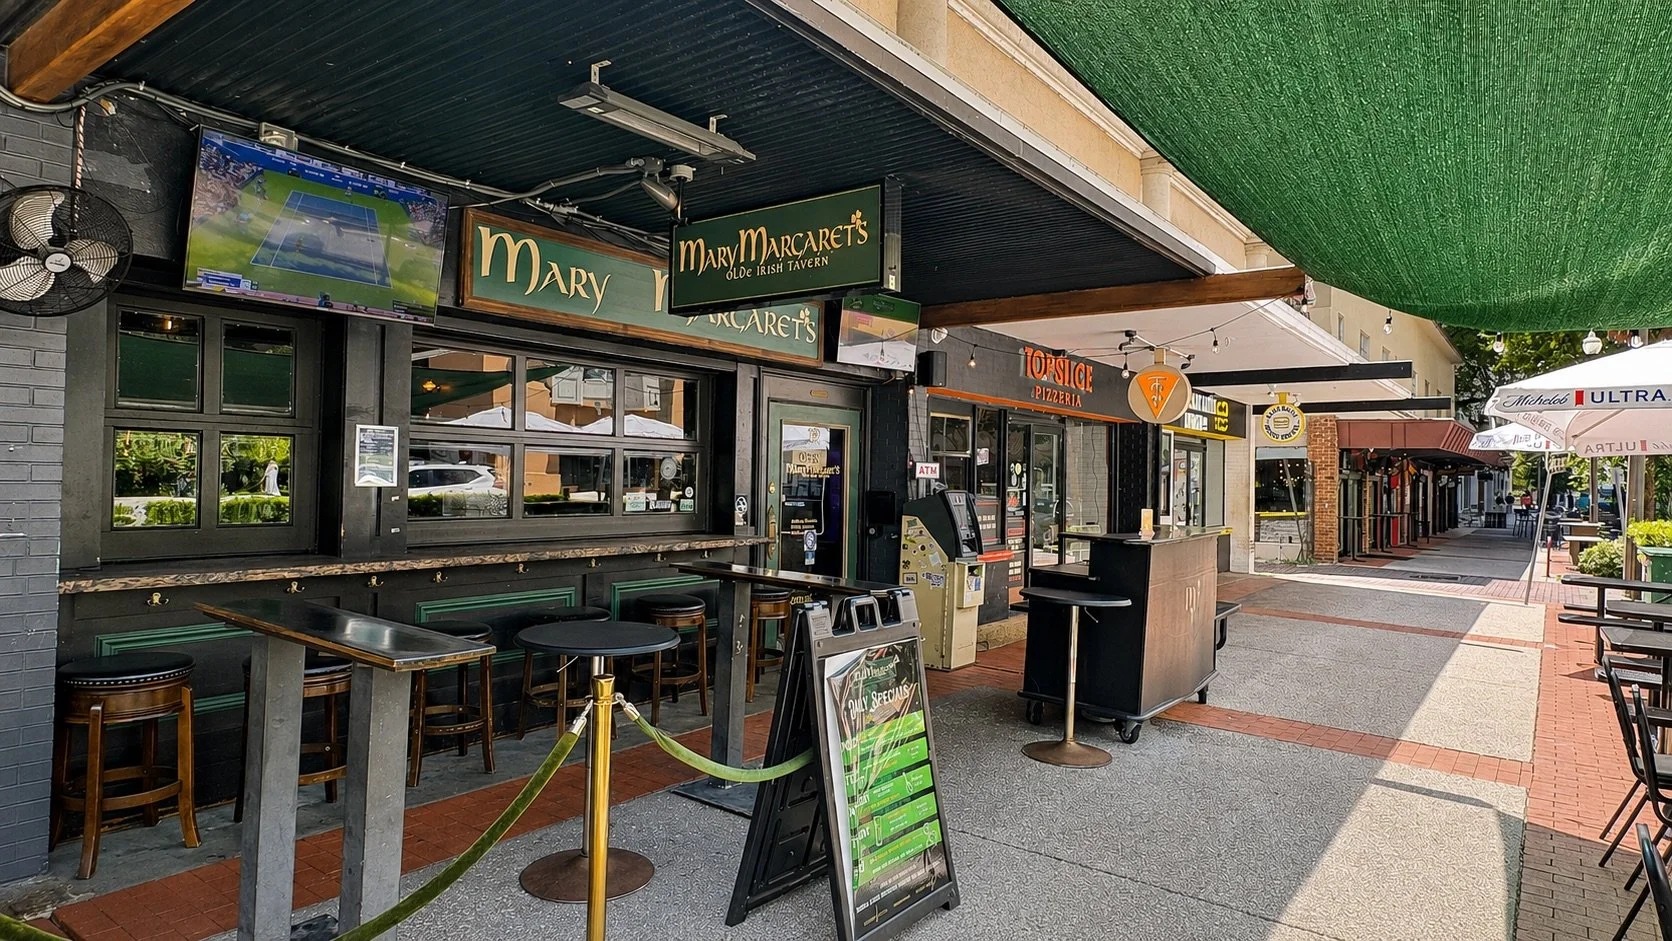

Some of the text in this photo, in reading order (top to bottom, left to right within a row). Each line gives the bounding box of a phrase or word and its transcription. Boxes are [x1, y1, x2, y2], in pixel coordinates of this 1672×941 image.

[756, 262, 783, 276] IRISH
[787, 256, 829, 271] TAVERN
[1034, 384, 1082, 408] PIZZERIA
[1502, 393, 1571, 408] Michelob
[918, 465, 937, 475] ATM
